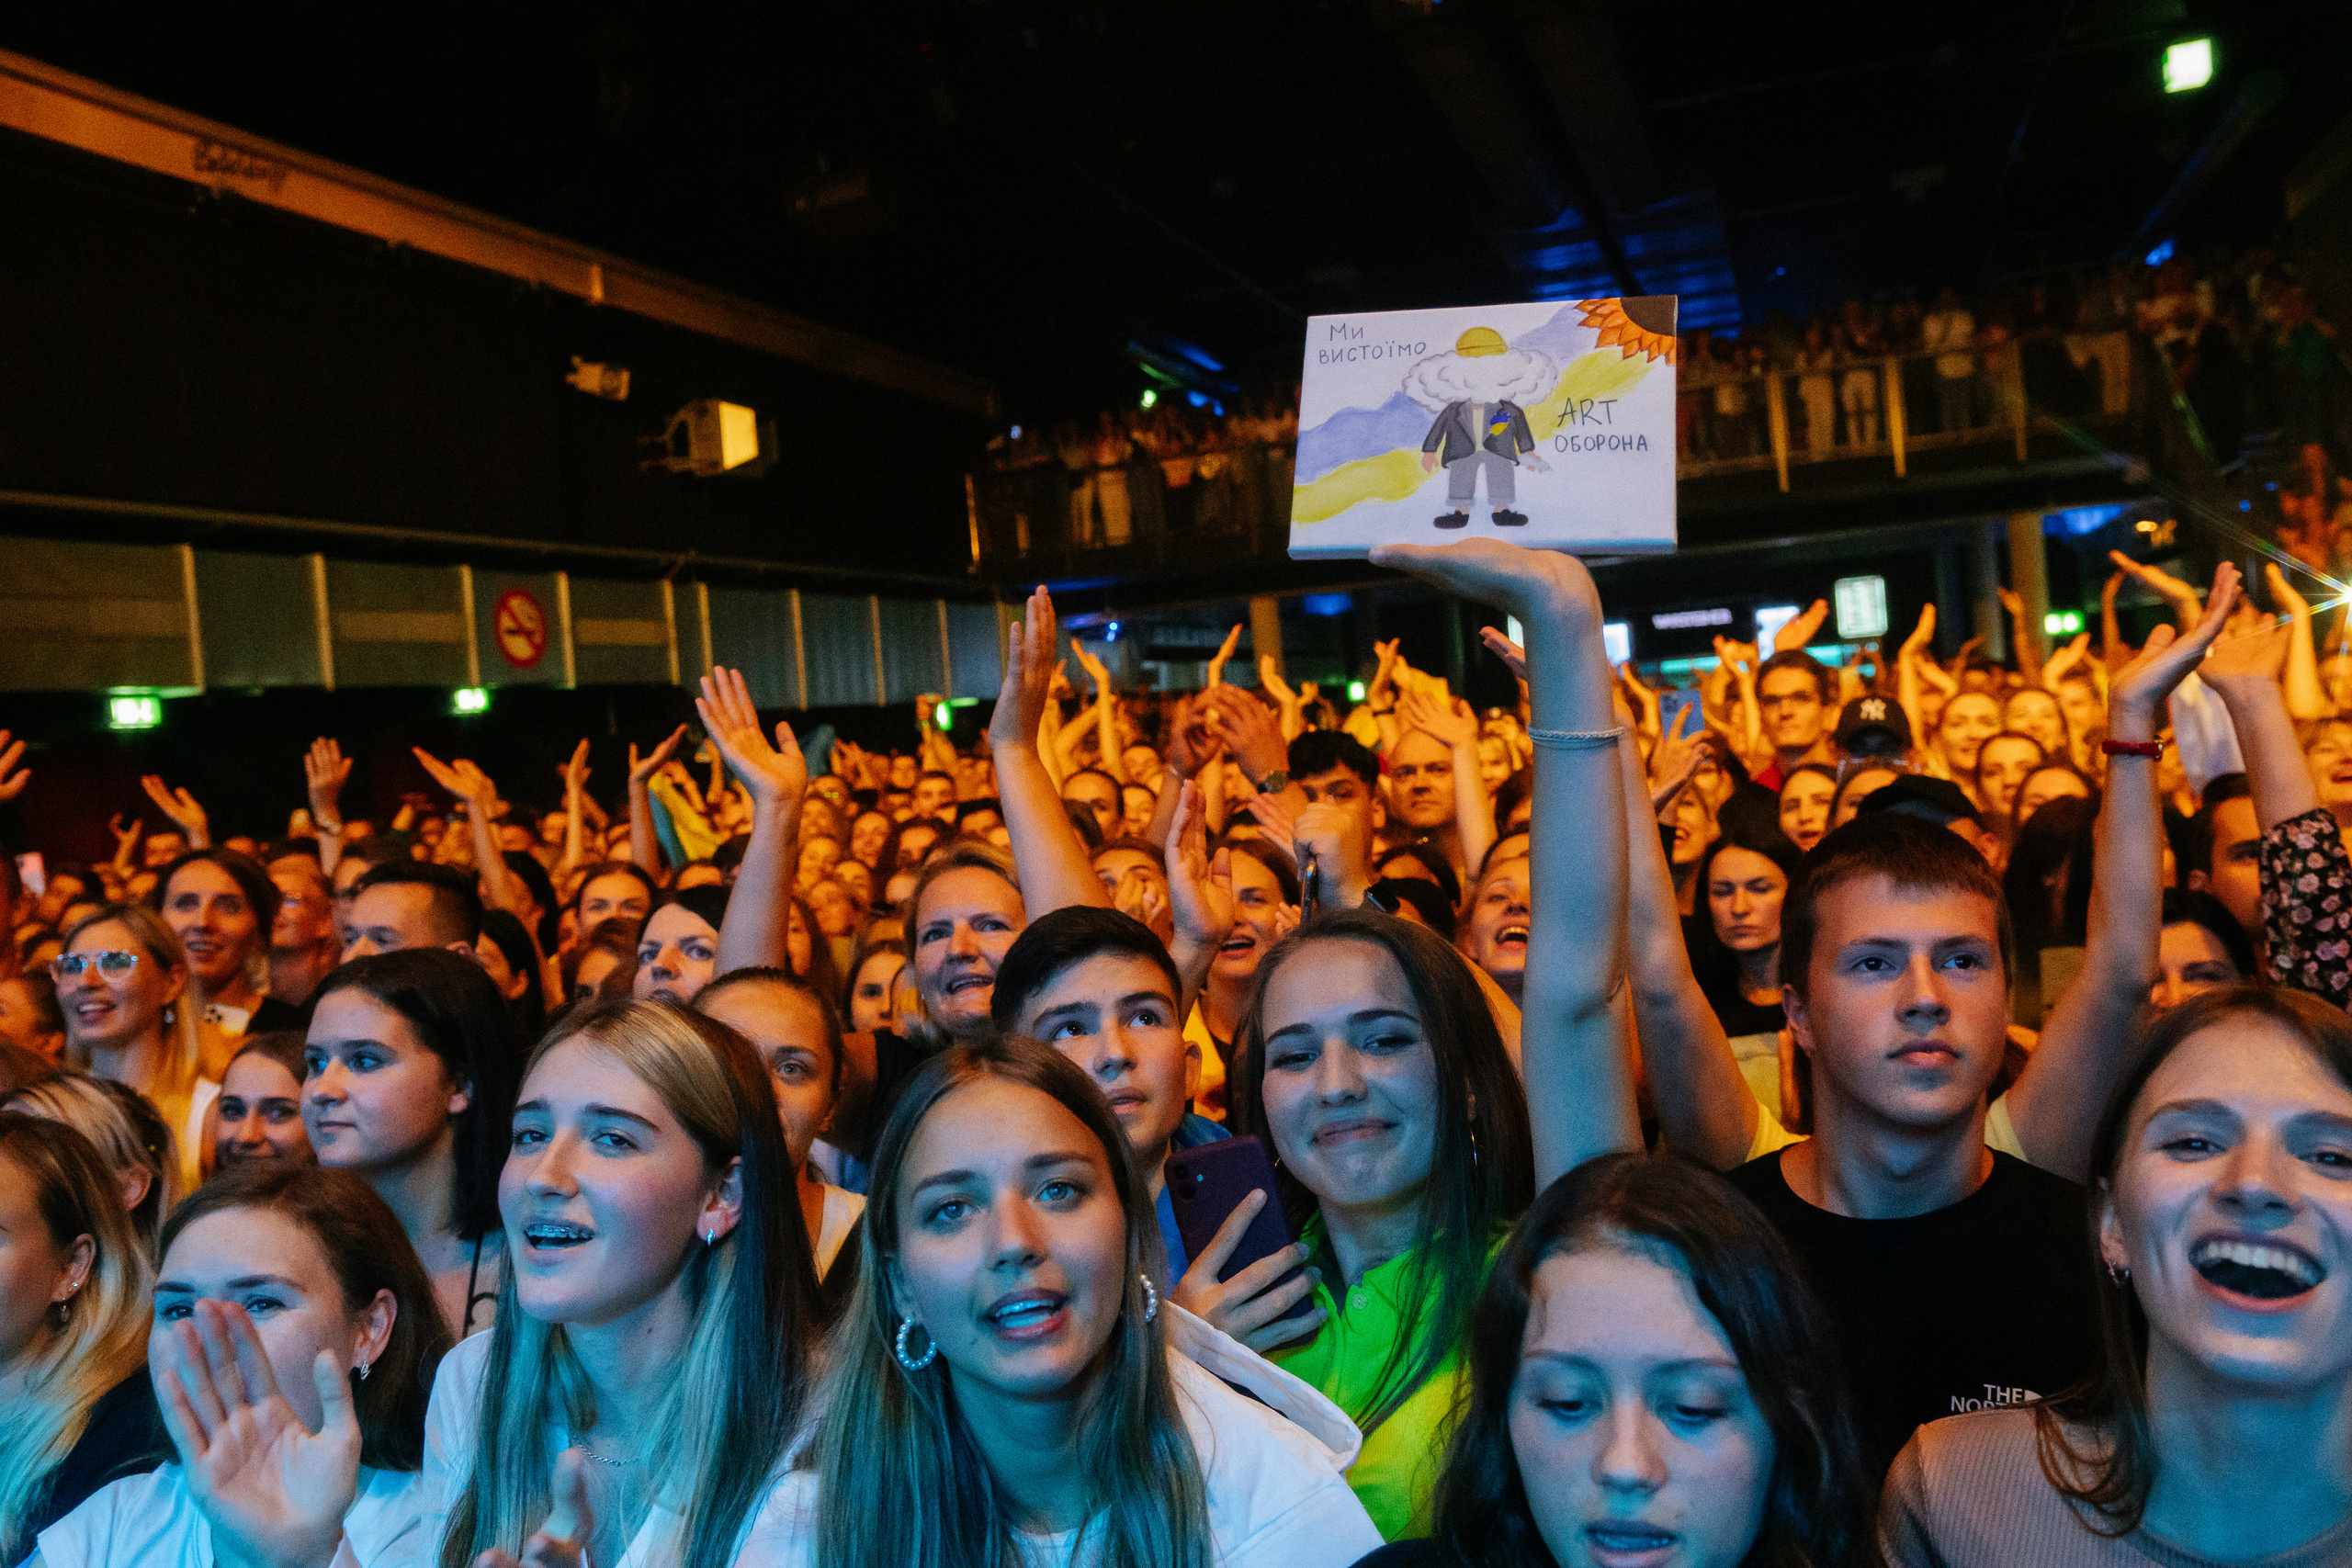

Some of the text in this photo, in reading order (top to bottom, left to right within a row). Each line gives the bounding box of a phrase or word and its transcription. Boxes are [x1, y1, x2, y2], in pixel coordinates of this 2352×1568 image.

[1557, 397, 1618, 427] ART
[1555, 434, 1648, 453] ОБОРОНА
[1951, 1394, 2007, 1413] NOR
[1983, 1383, 2023, 1404] THE
